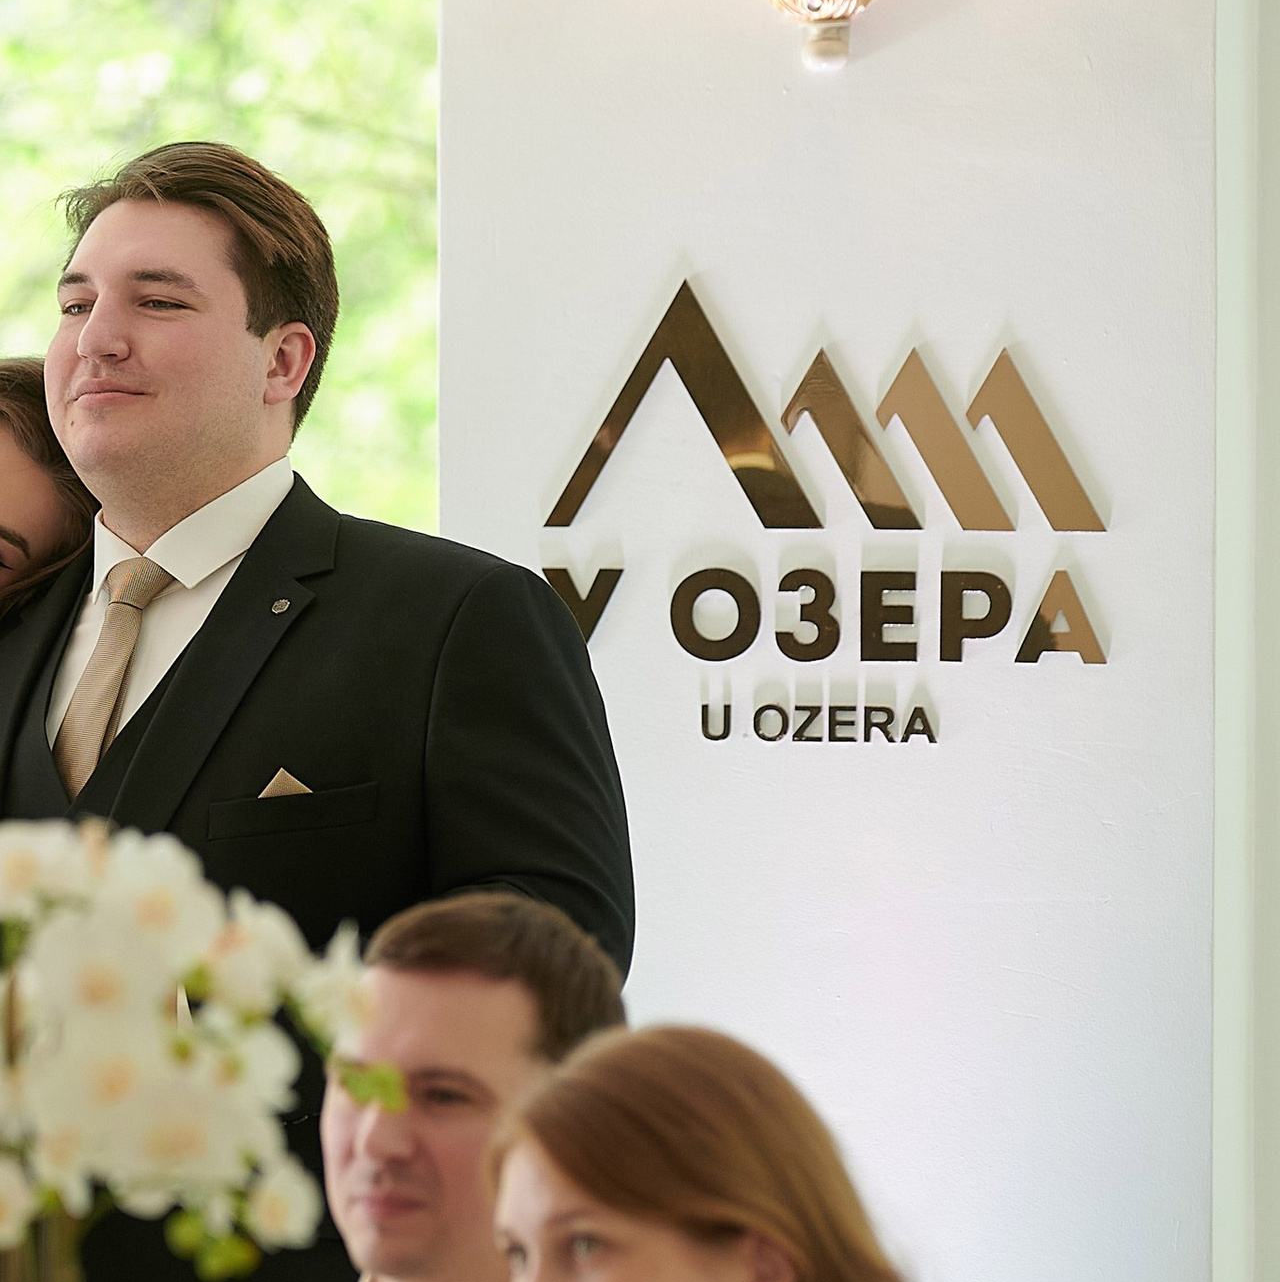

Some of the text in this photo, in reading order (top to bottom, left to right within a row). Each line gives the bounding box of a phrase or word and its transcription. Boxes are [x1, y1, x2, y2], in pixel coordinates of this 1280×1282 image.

[670, 568, 1108, 664] ОЗЕРА
[701, 703, 938, 743] U OZERA
